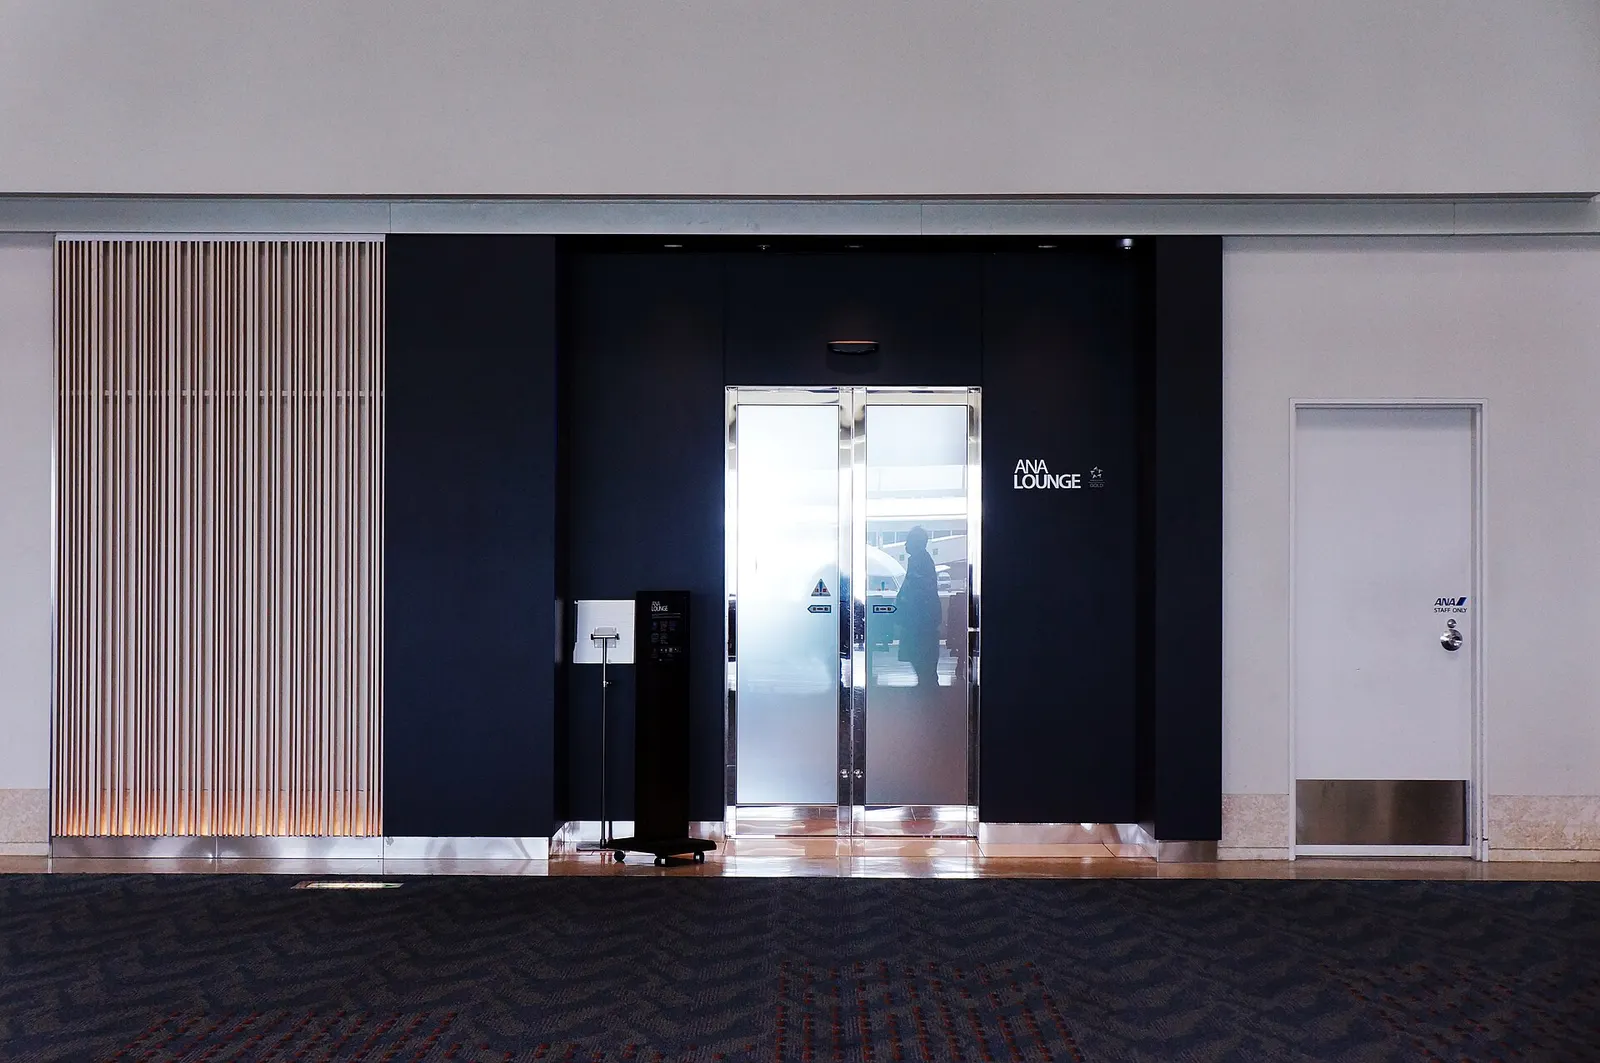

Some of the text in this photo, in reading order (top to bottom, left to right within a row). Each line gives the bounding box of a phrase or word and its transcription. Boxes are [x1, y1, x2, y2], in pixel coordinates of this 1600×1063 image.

[1014, 459, 1048, 473] ANA
[1013, 474, 1081, 488] LOUNGE
[1434, 597, 1456, 606] ANA
